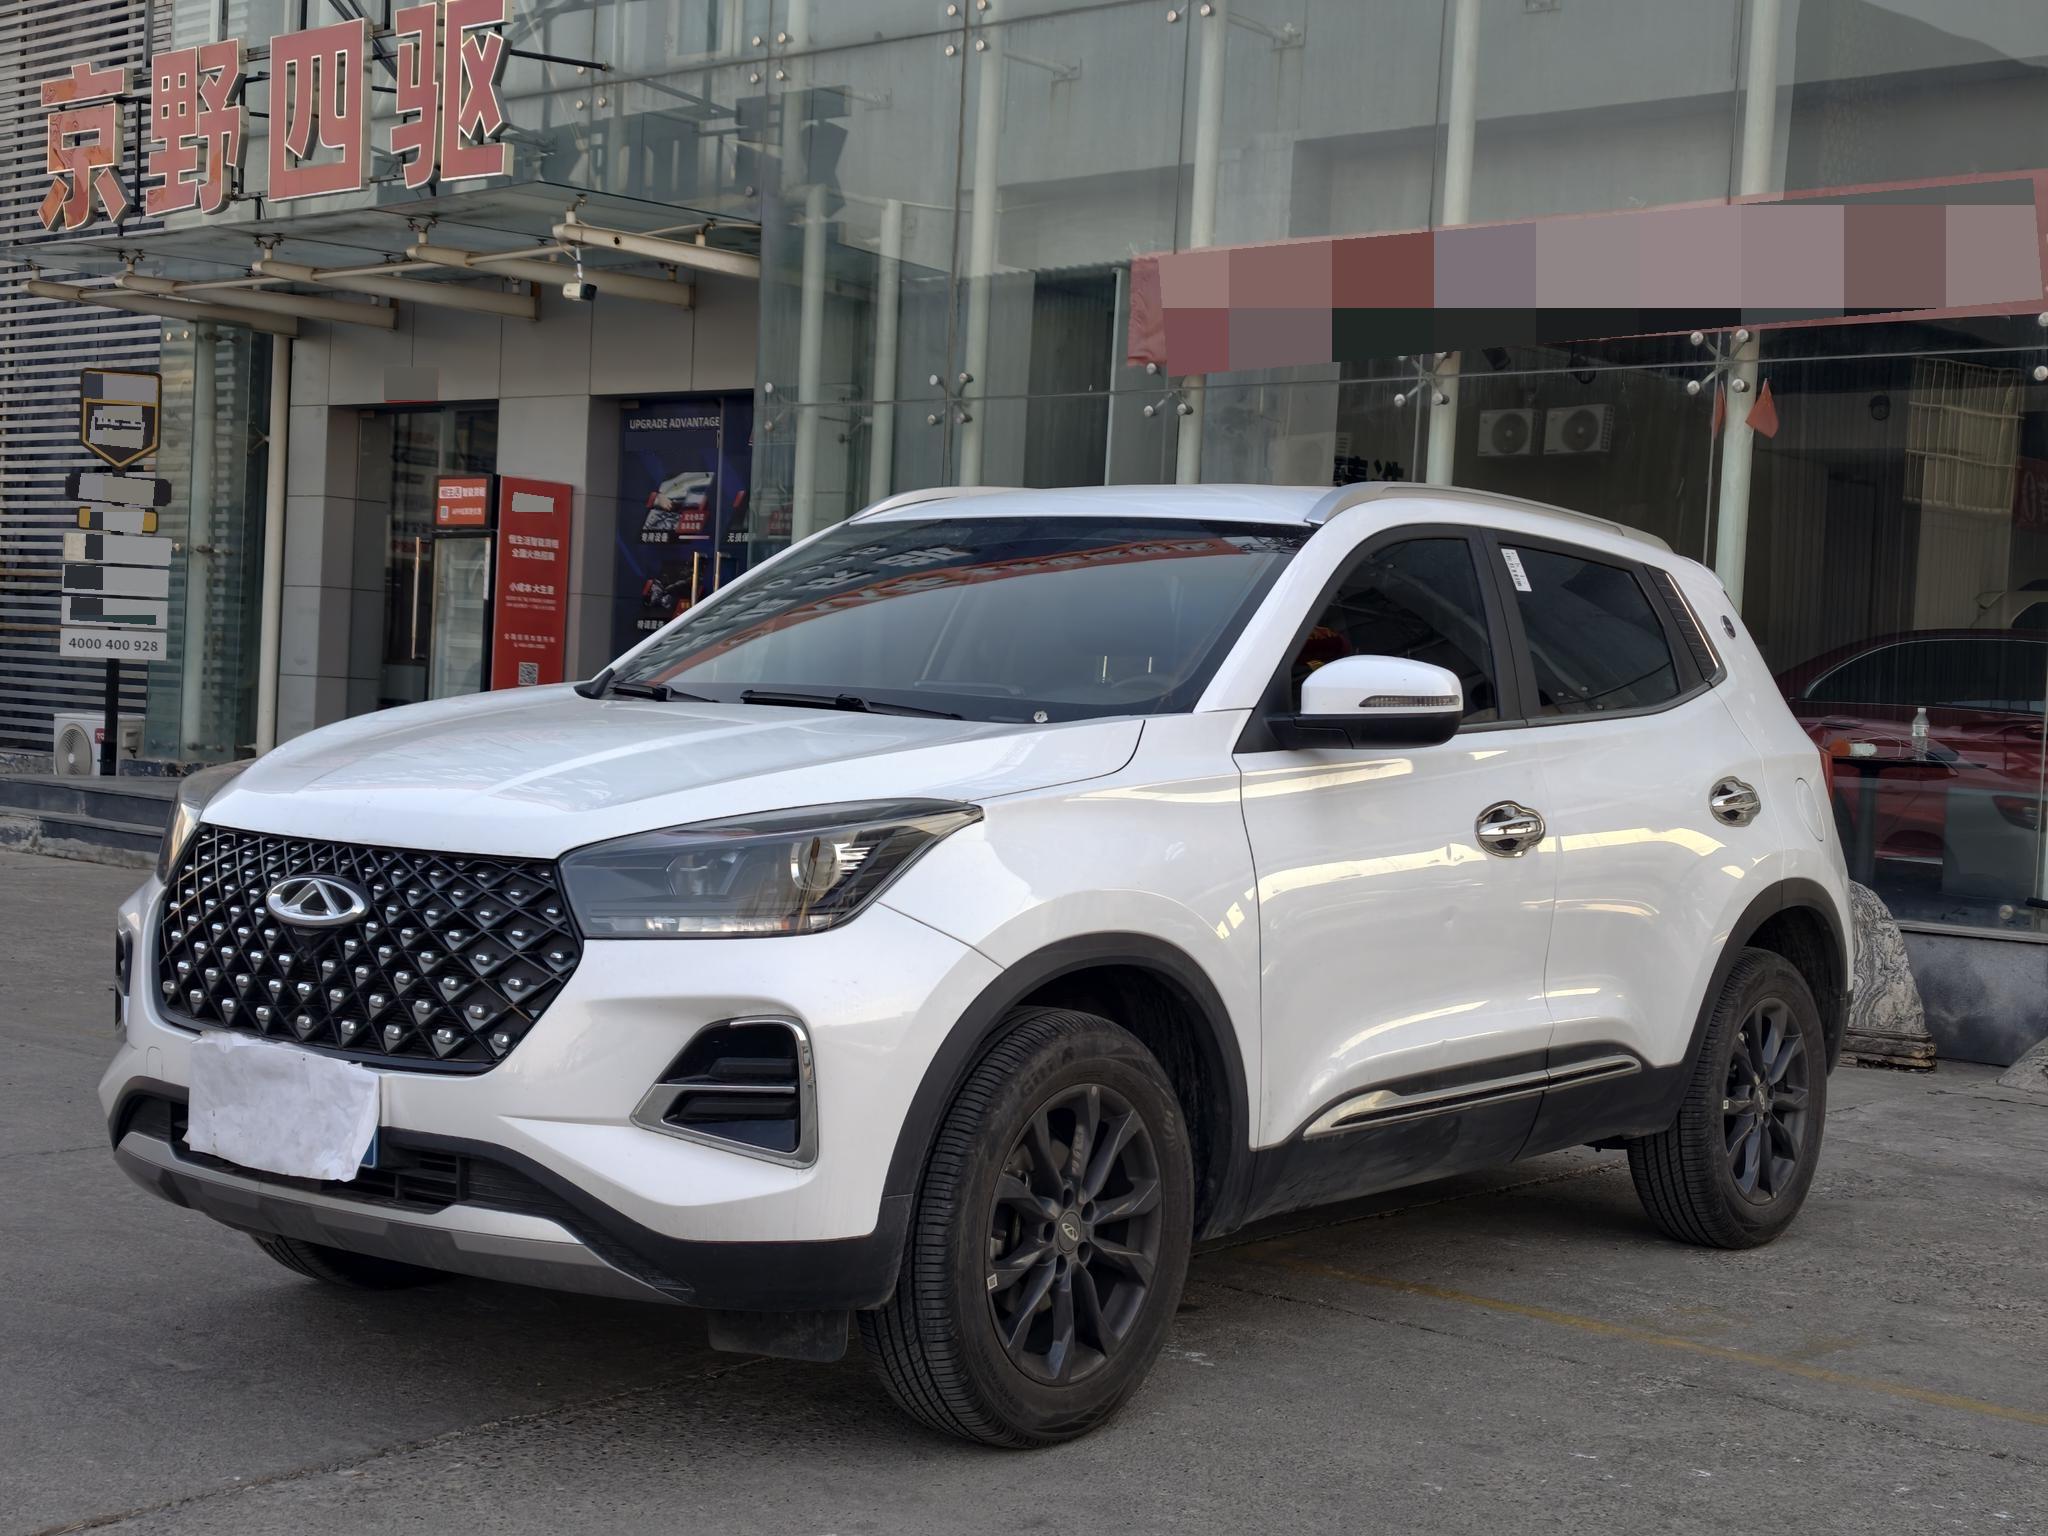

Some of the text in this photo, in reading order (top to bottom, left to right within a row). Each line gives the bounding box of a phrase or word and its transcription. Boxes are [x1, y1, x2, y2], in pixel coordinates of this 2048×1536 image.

[37, 0, 512, 231] 京野四驱
[629, 416, 720, 430] UPGRADE ADVANTAGE
[69, 637, 158, 652] 4000 400 928
